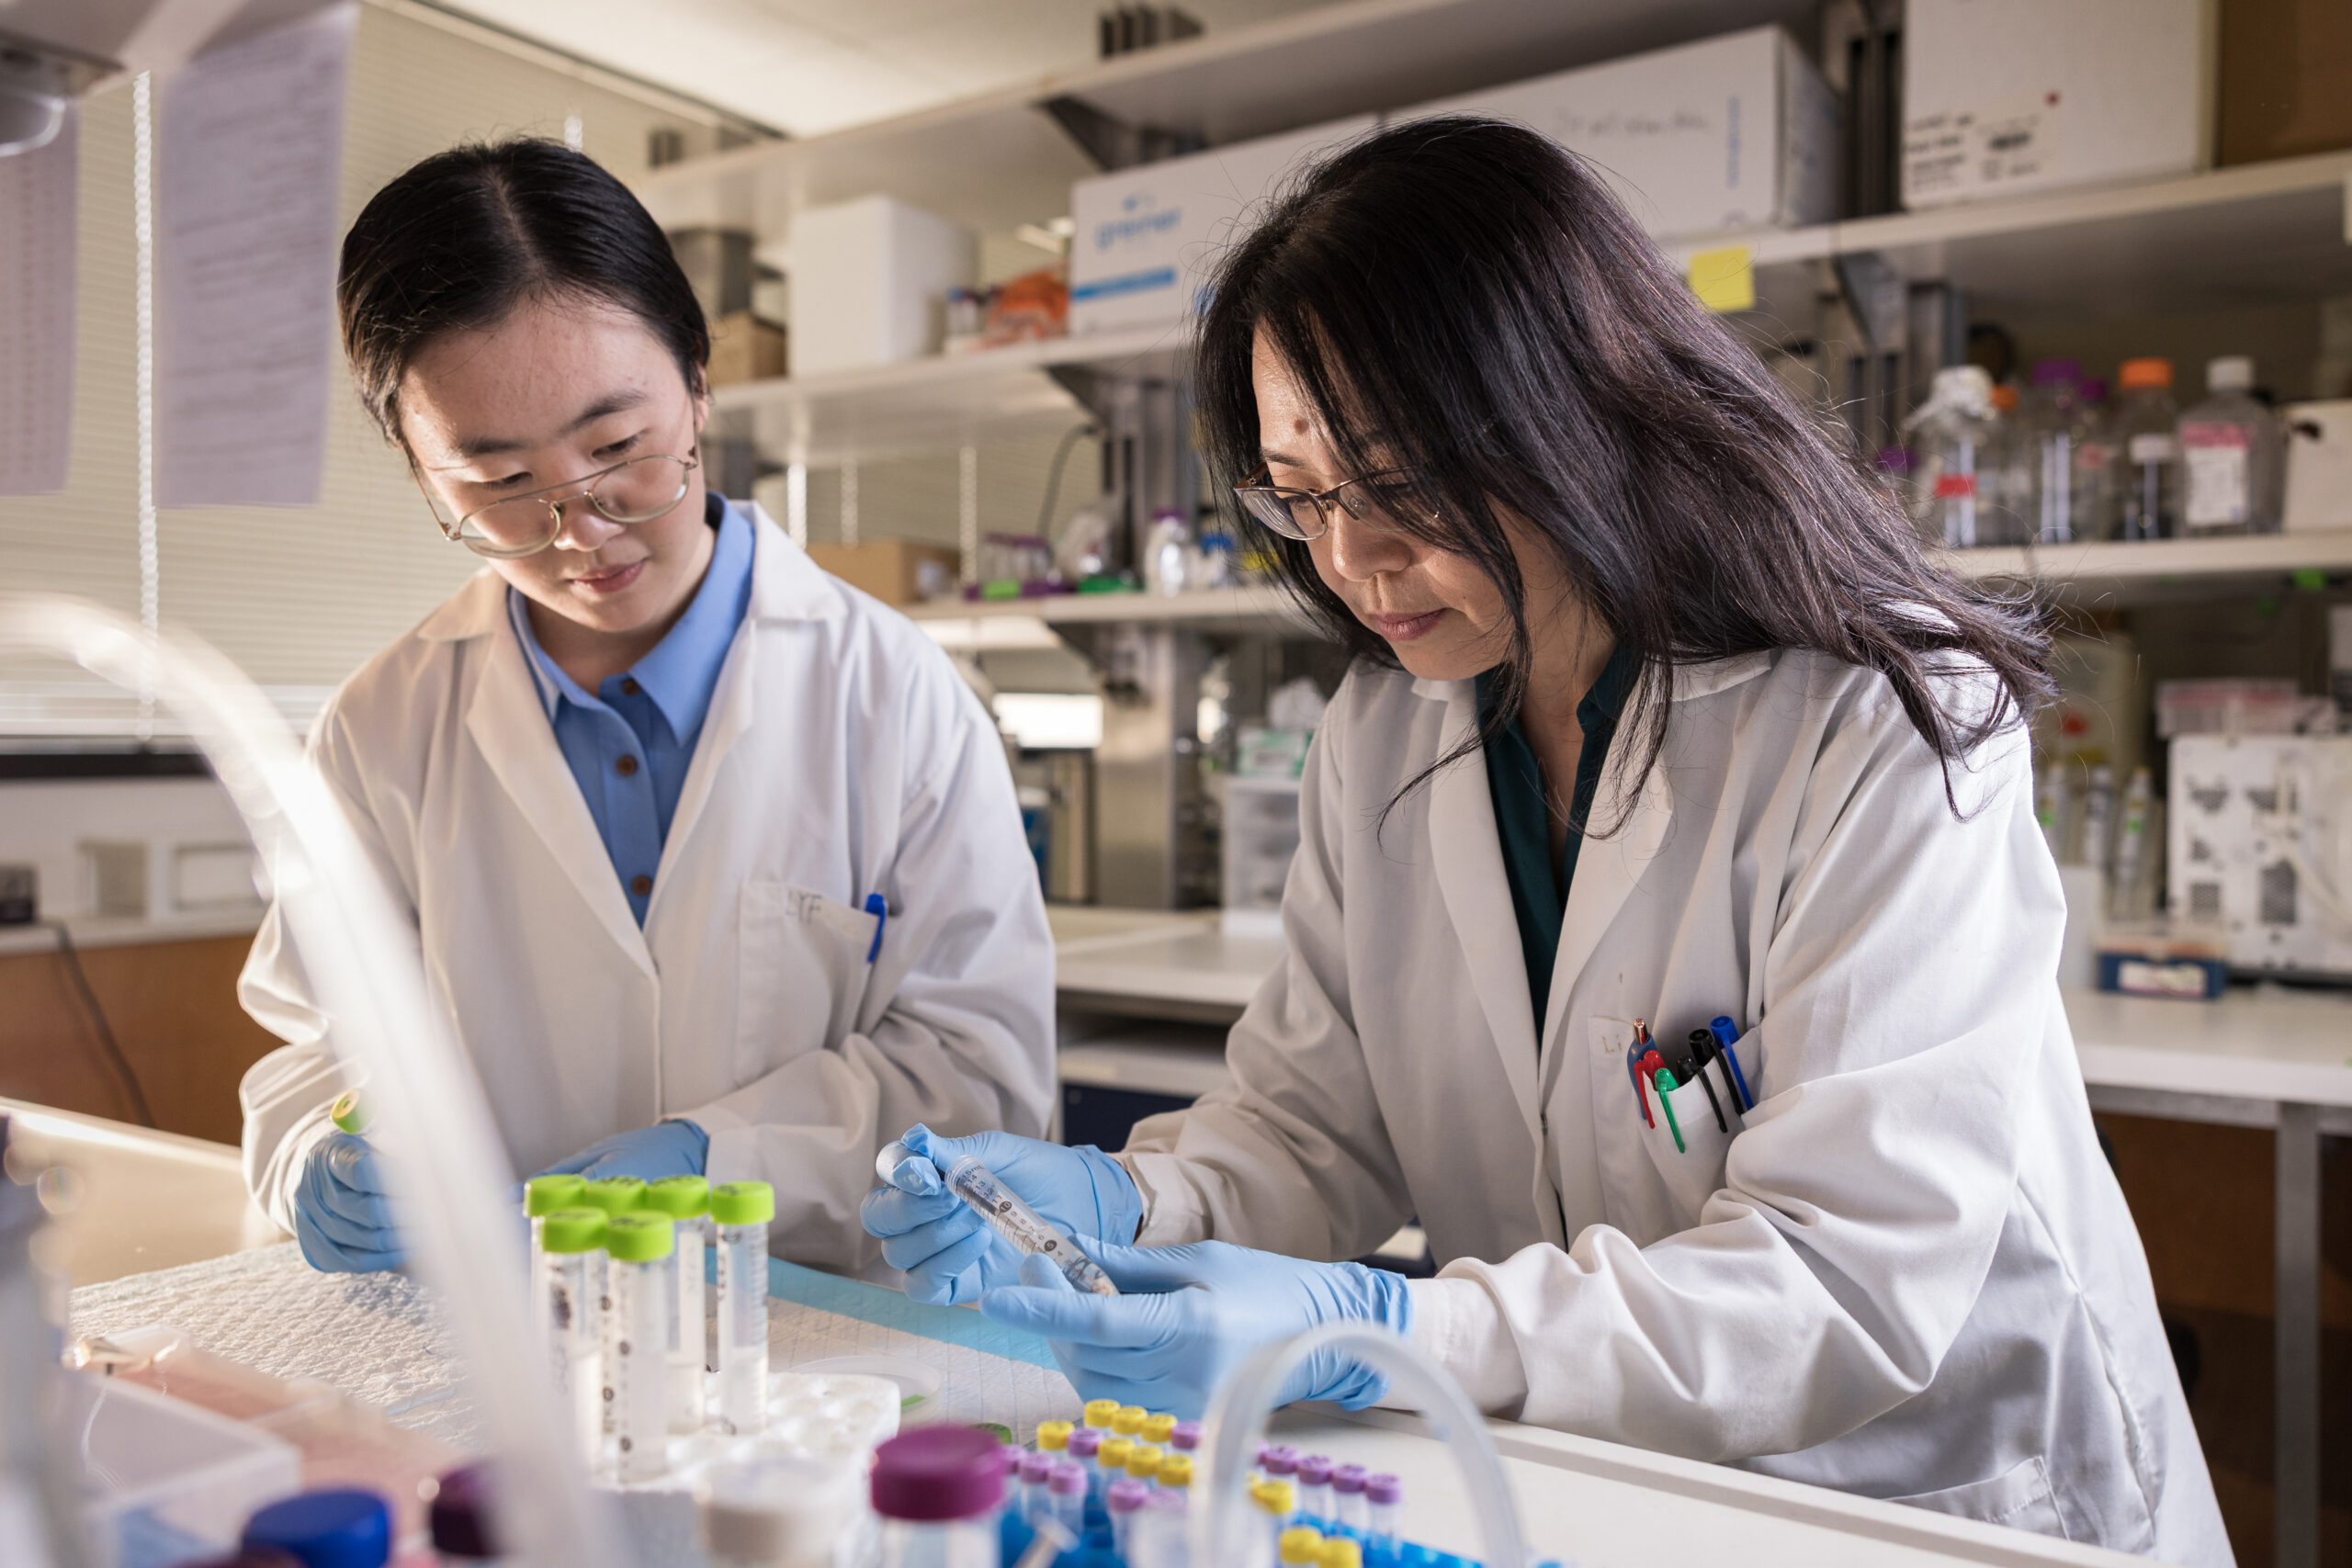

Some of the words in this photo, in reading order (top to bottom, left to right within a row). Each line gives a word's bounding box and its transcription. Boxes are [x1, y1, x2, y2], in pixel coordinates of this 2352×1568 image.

[1601, 1033, 1622, 1055] Li
[967, 1174, 978, 1184] 14
[975, 1180, 986, 1190] 13
[983, 1187, 995, 1199] 12
[992, 1194, 1002, 1204] 11
[1000, 1201, 1012, 1212] 10
